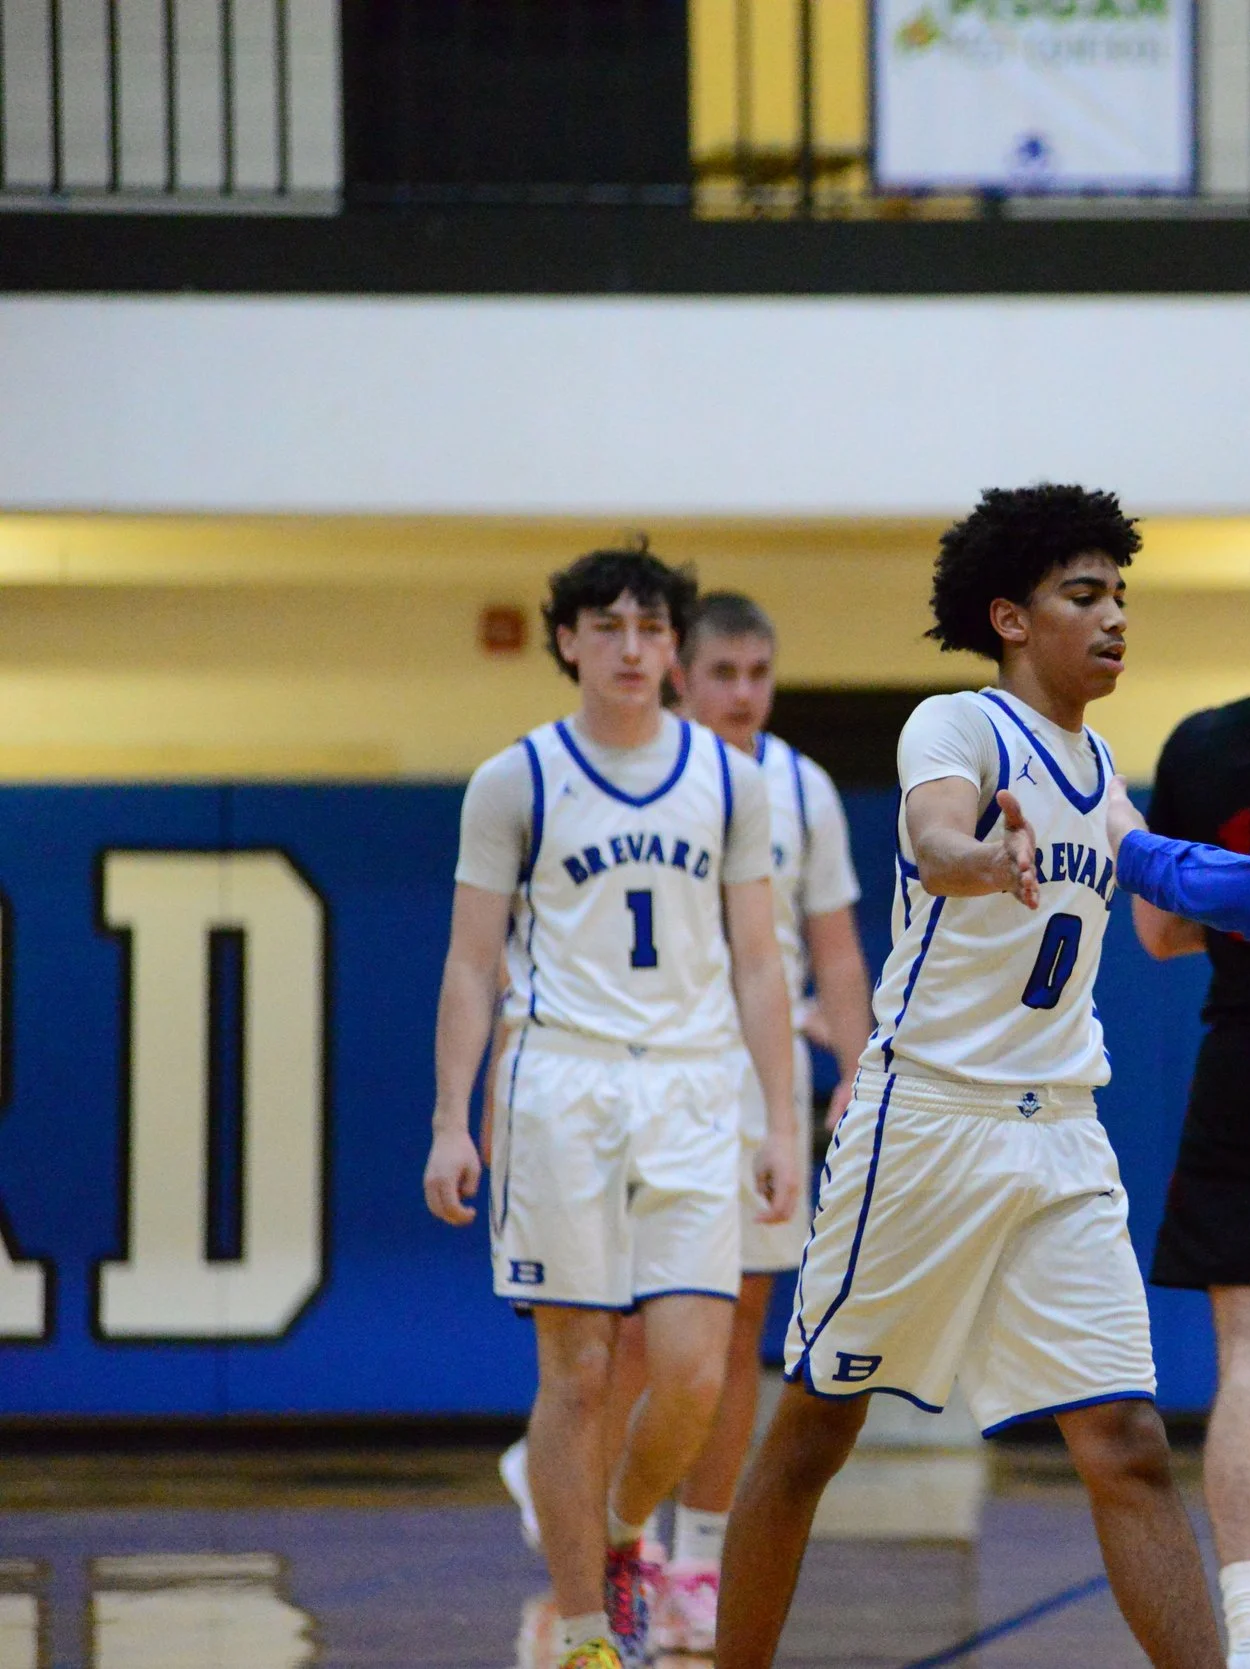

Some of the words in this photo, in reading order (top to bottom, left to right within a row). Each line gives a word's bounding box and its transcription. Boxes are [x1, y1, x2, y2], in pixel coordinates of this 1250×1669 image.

[562, 832, 709, 886] BREVARD
[626, 889, 658, 968] 1
[1021, 913, 1083, 1010] 0
[0, 846, 330, 1344] D
[507, 1260, 546, 1285] B
[832, 1351, 883, 1383] B
